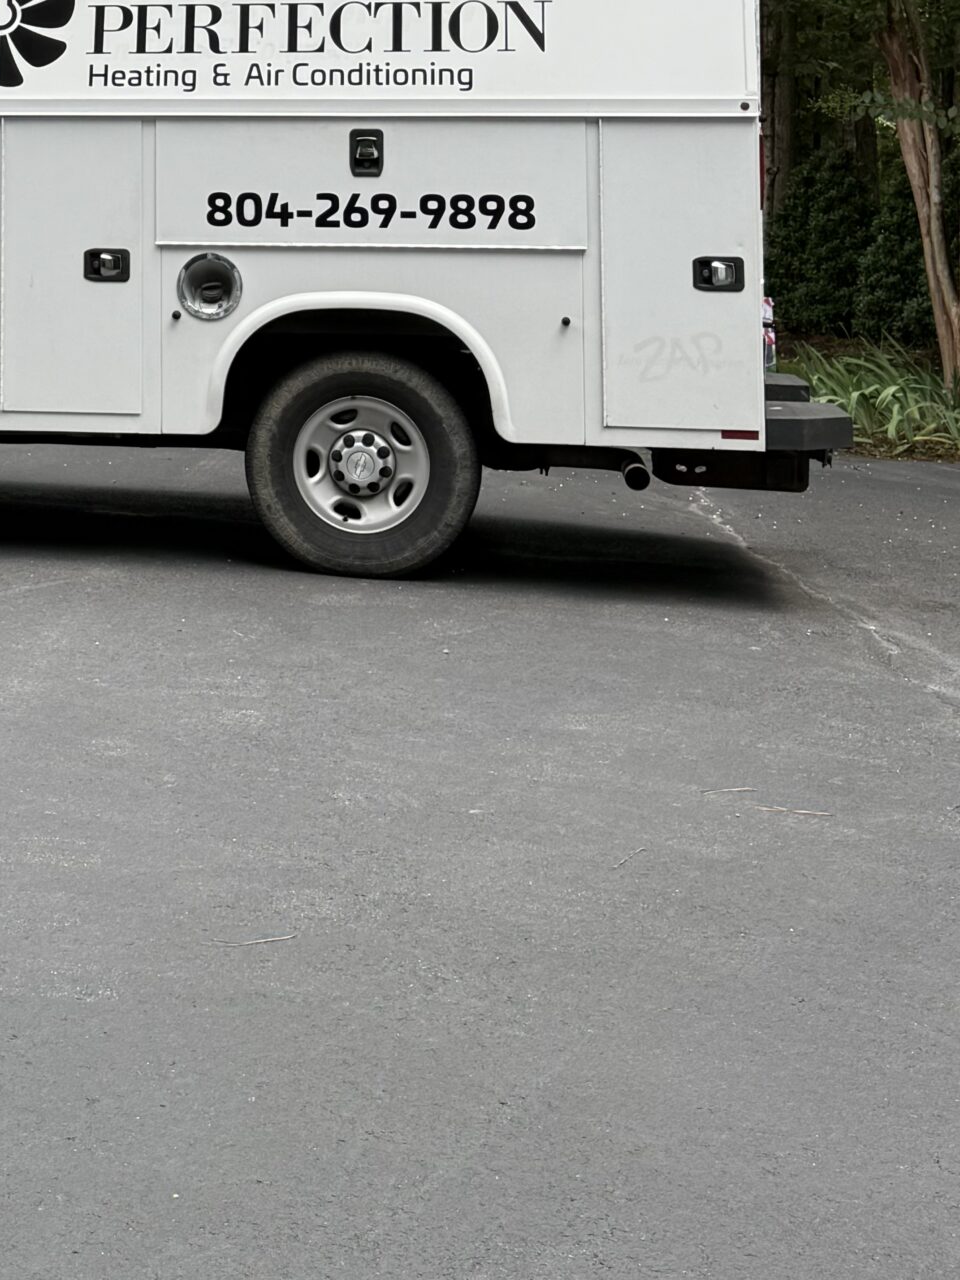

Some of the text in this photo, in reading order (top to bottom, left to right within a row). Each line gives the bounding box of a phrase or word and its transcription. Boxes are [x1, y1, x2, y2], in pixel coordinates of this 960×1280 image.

[85, 0, 553, 55] PERFECTION
[88, 61, 473, 93] Heating & Air Conditioning
[206, 191, 536, 231] 804-269-9898
